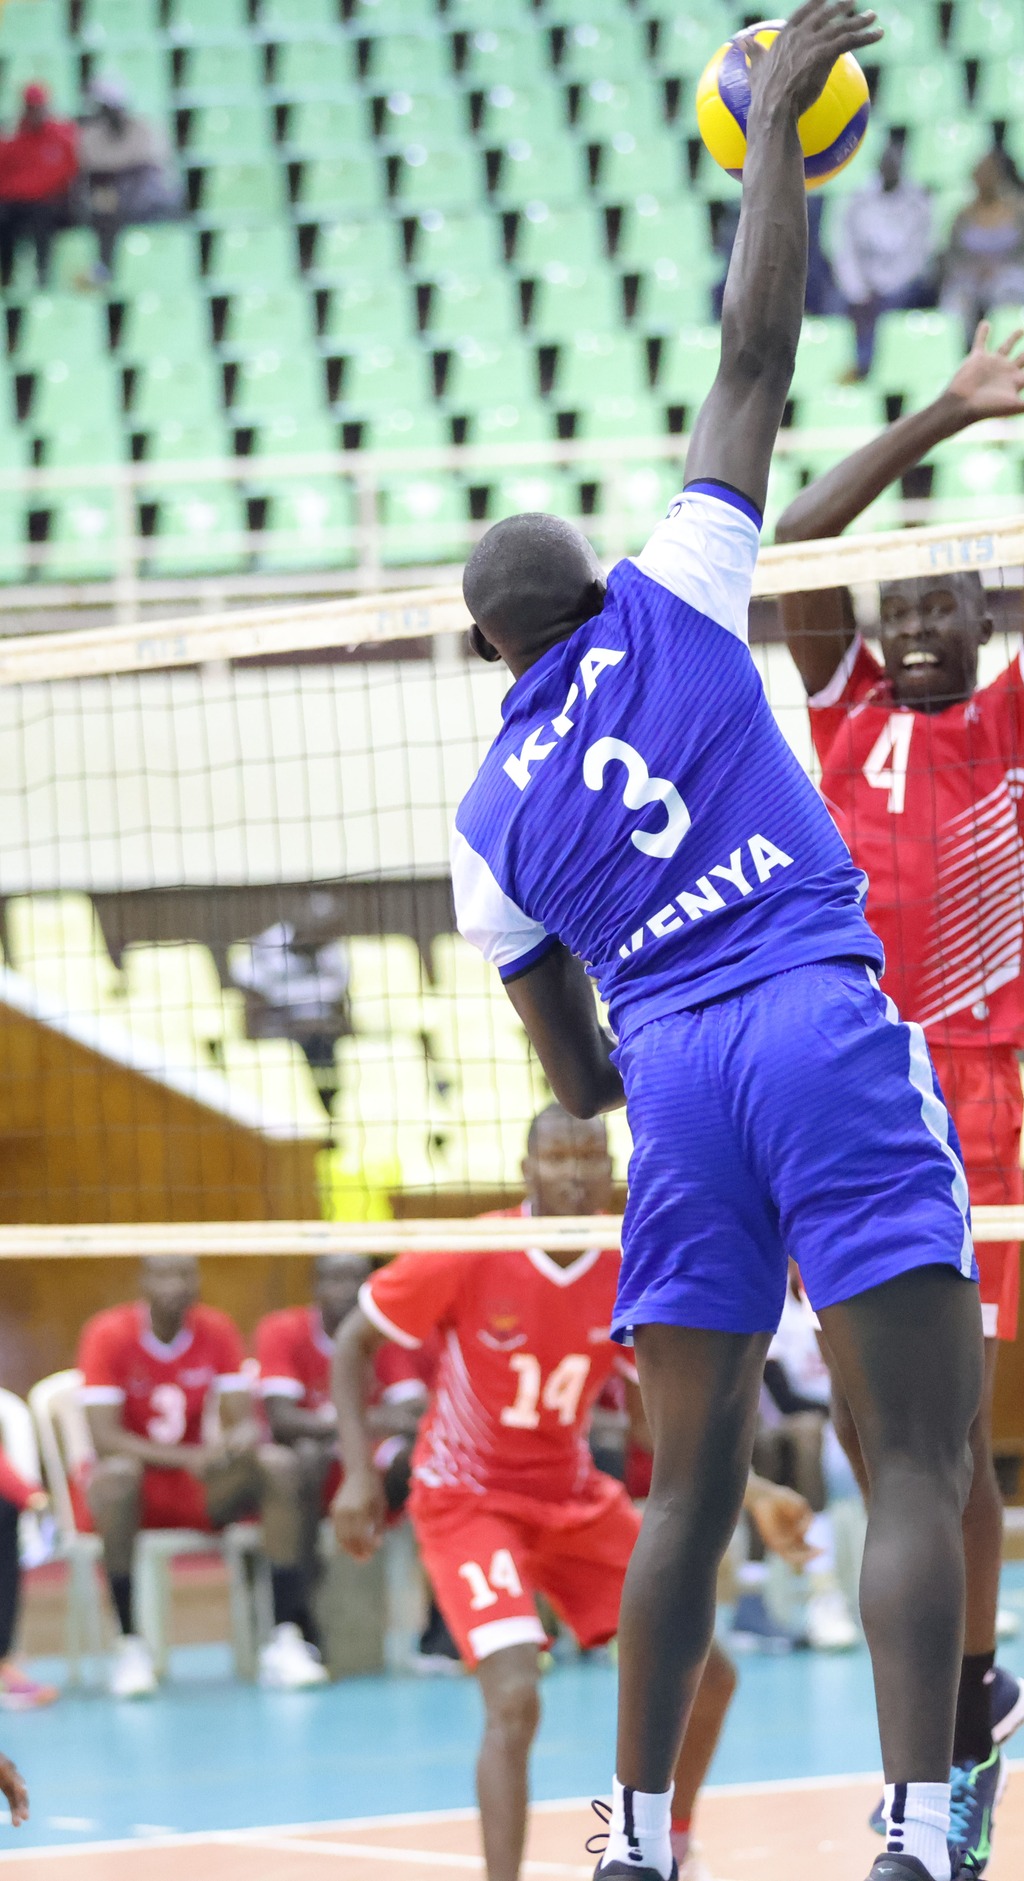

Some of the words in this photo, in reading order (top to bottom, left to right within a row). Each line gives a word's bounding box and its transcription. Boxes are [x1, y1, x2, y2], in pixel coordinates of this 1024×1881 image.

[583, 736, 692, 859] 3
[863, 712, 916, 815] 4
[147, 1383, 188, 1443] 3
[500, 1353, 591, 1429] 14
[458, 1548, 523, 1611] 14
